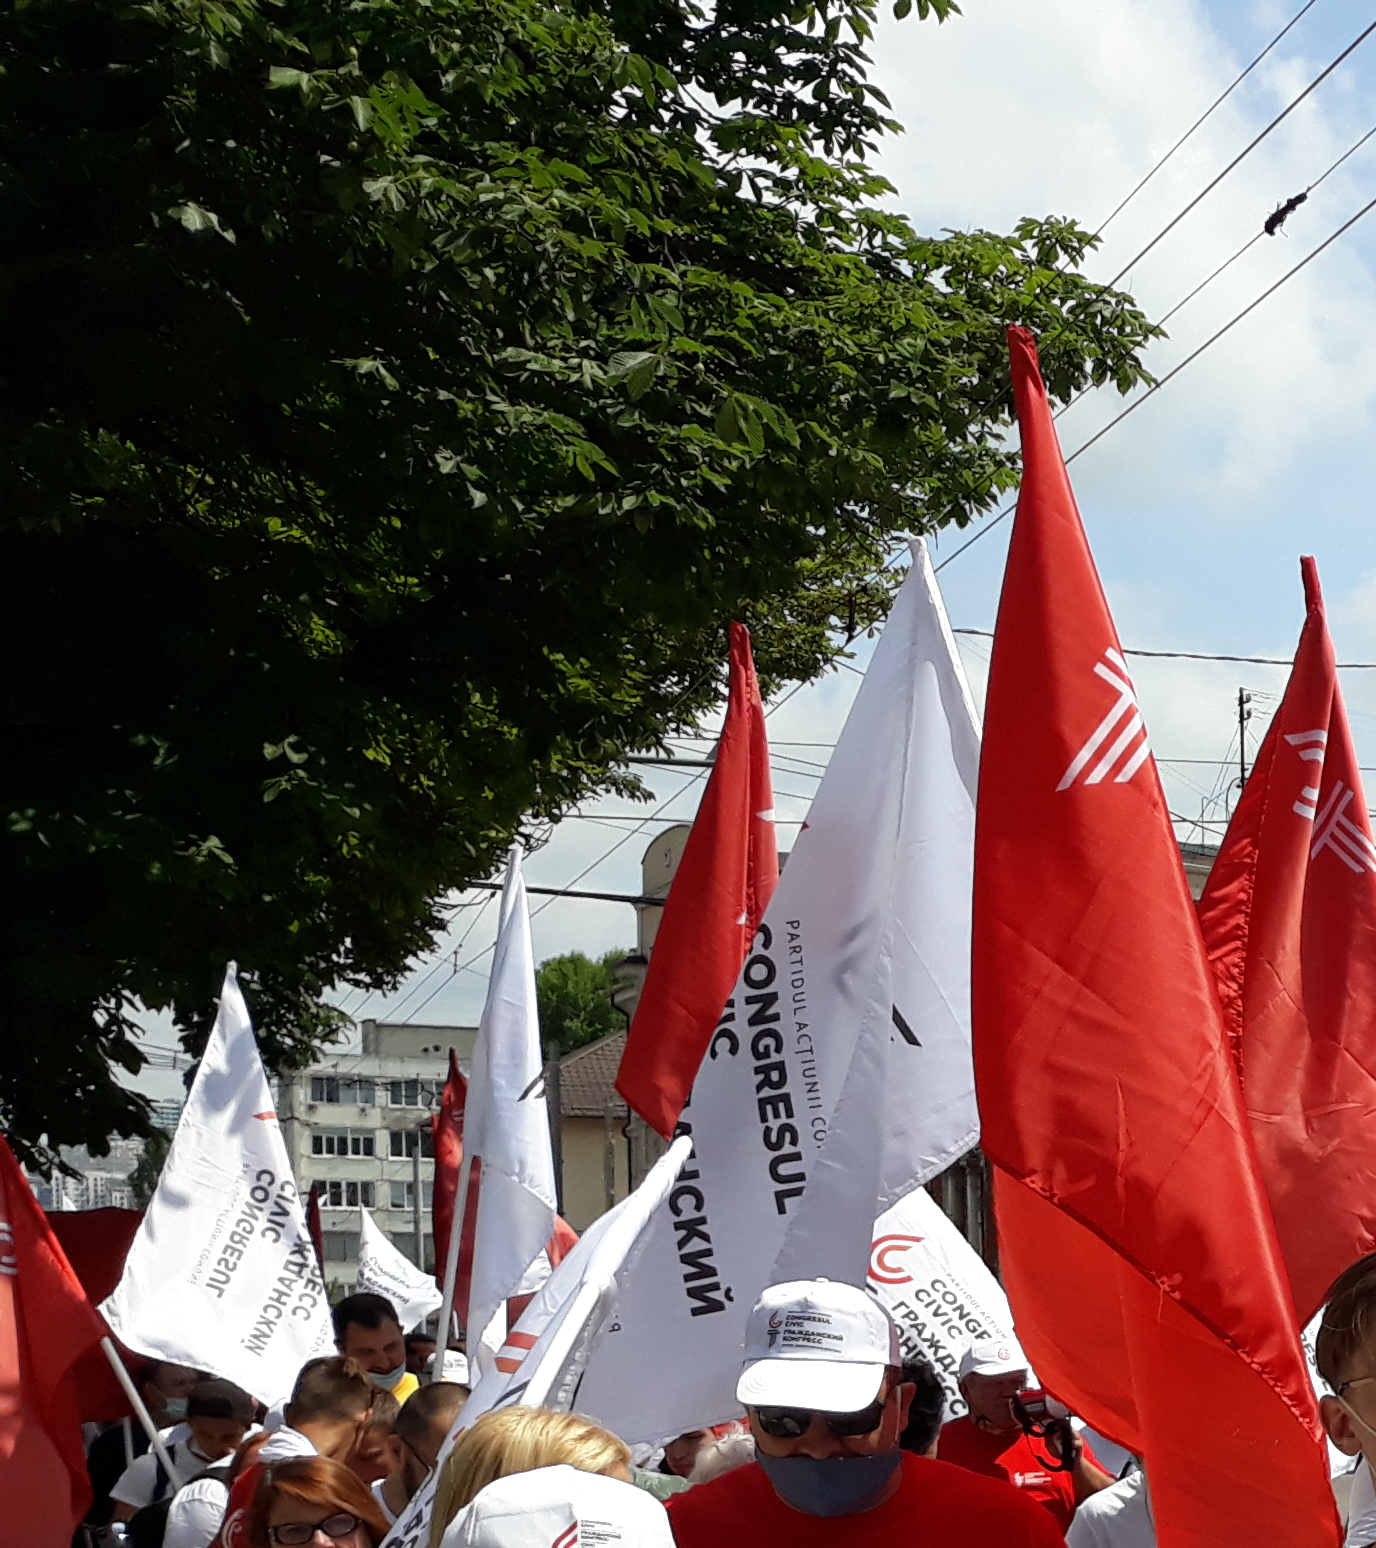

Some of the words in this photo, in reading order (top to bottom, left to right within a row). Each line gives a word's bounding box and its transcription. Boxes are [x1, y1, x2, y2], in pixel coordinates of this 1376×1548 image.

[785, 919, 807, 1016] PARTIDUL
[743, 922, 807, 1216] CONGRESUL
[914, 1288, 963, 1340] CIVIC
